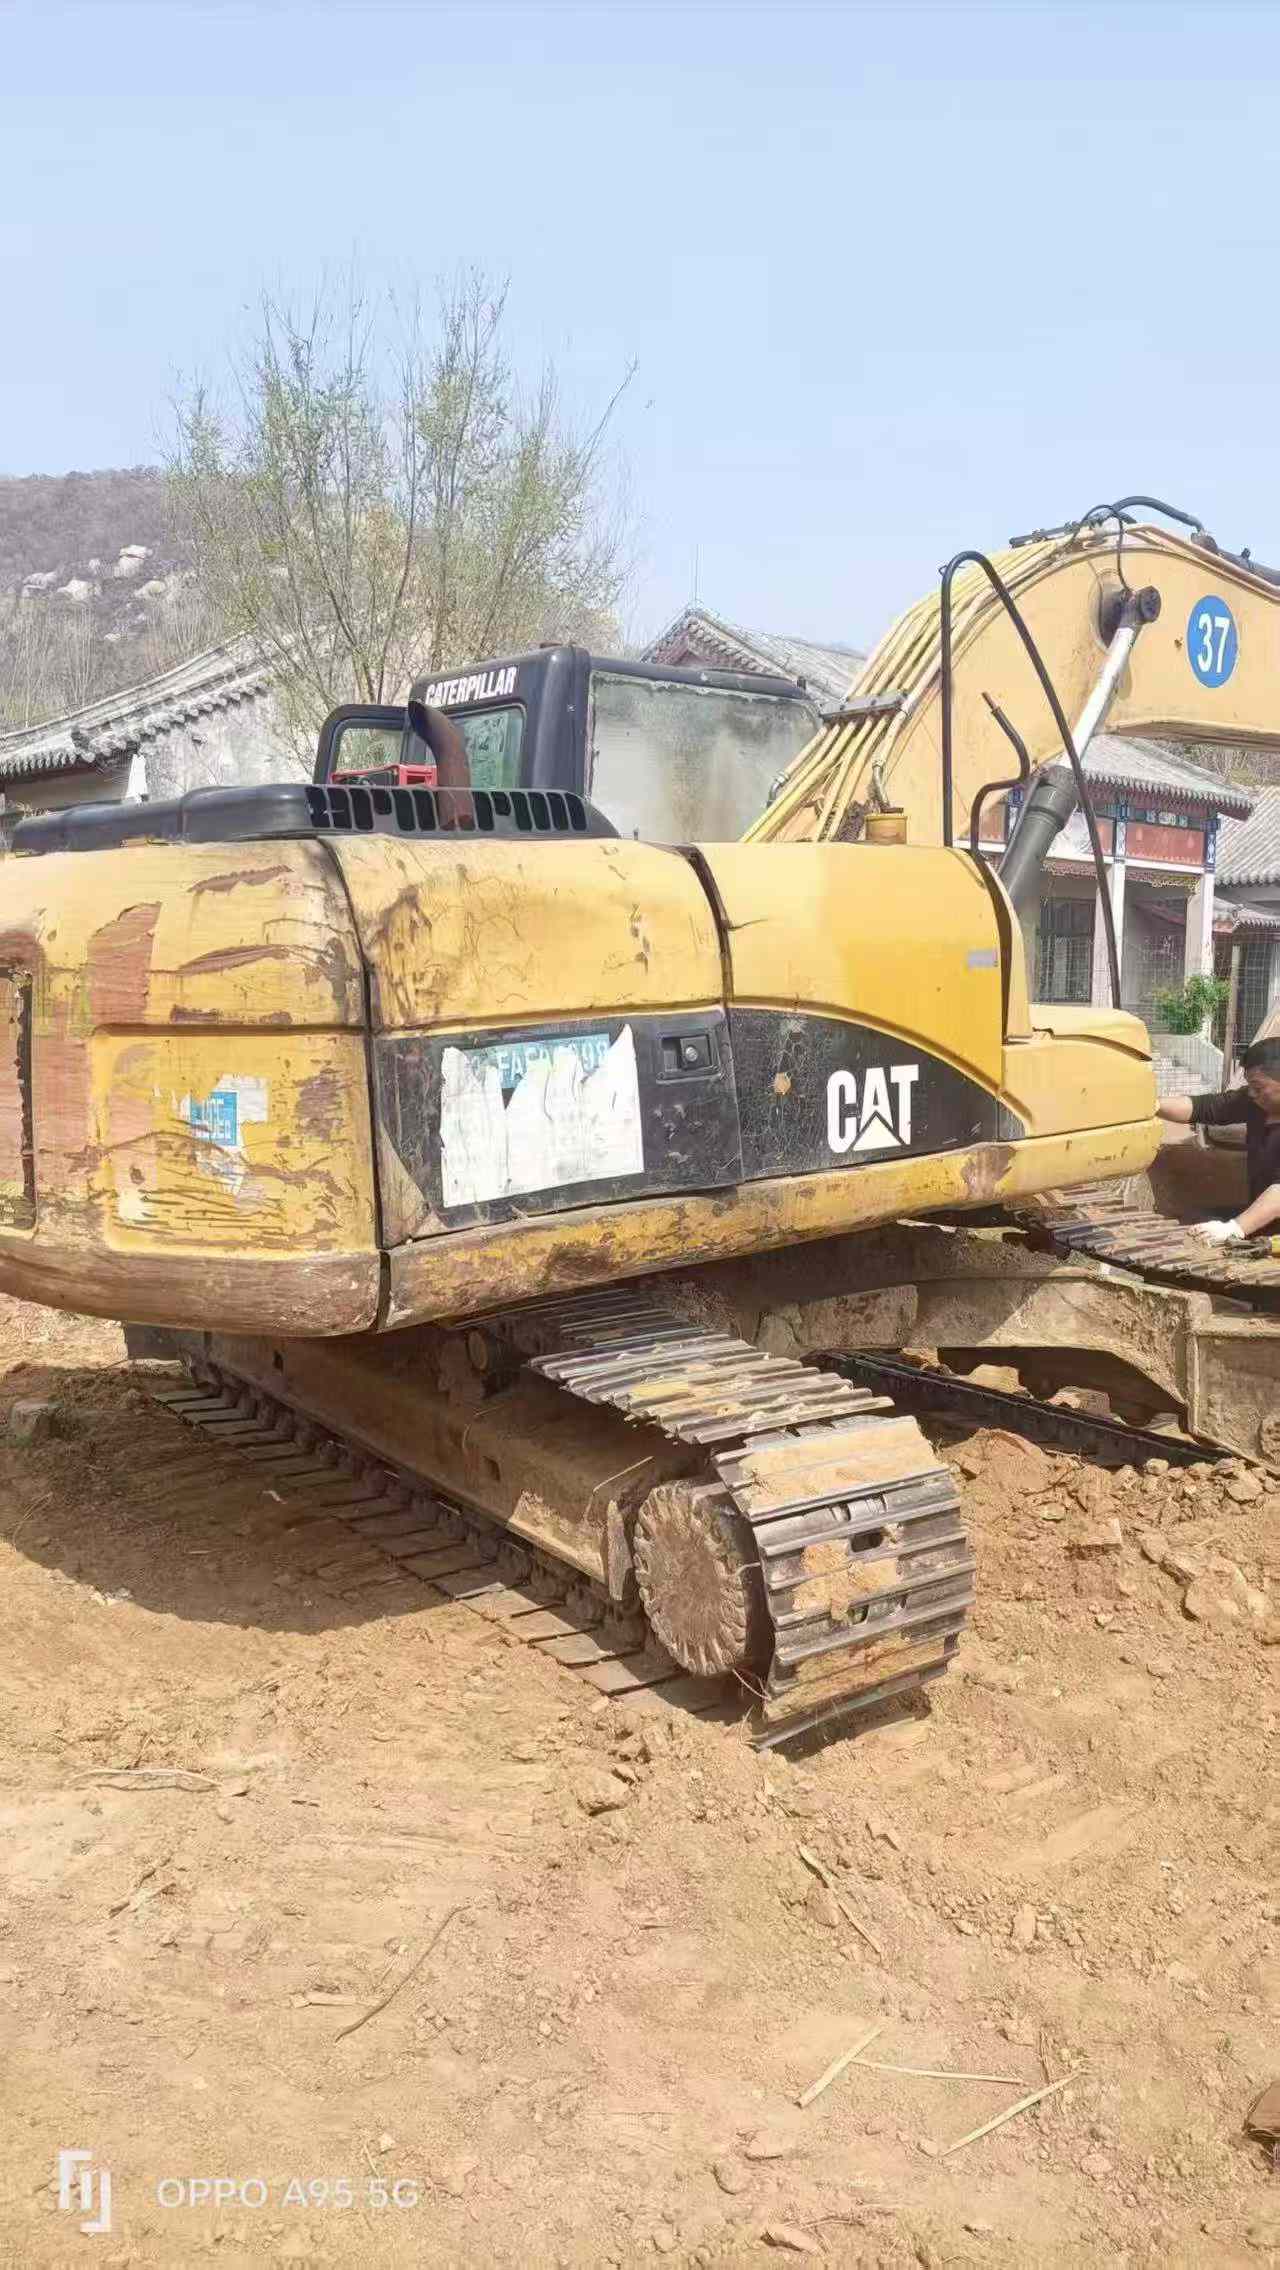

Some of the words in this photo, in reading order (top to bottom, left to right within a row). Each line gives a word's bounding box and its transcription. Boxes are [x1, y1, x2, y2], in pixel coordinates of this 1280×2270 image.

[1197, 613, 1231, 673] 37
[424, 665, 518, 707] CATERPILLAR
[826, 1063, 919, 1154] CAT
